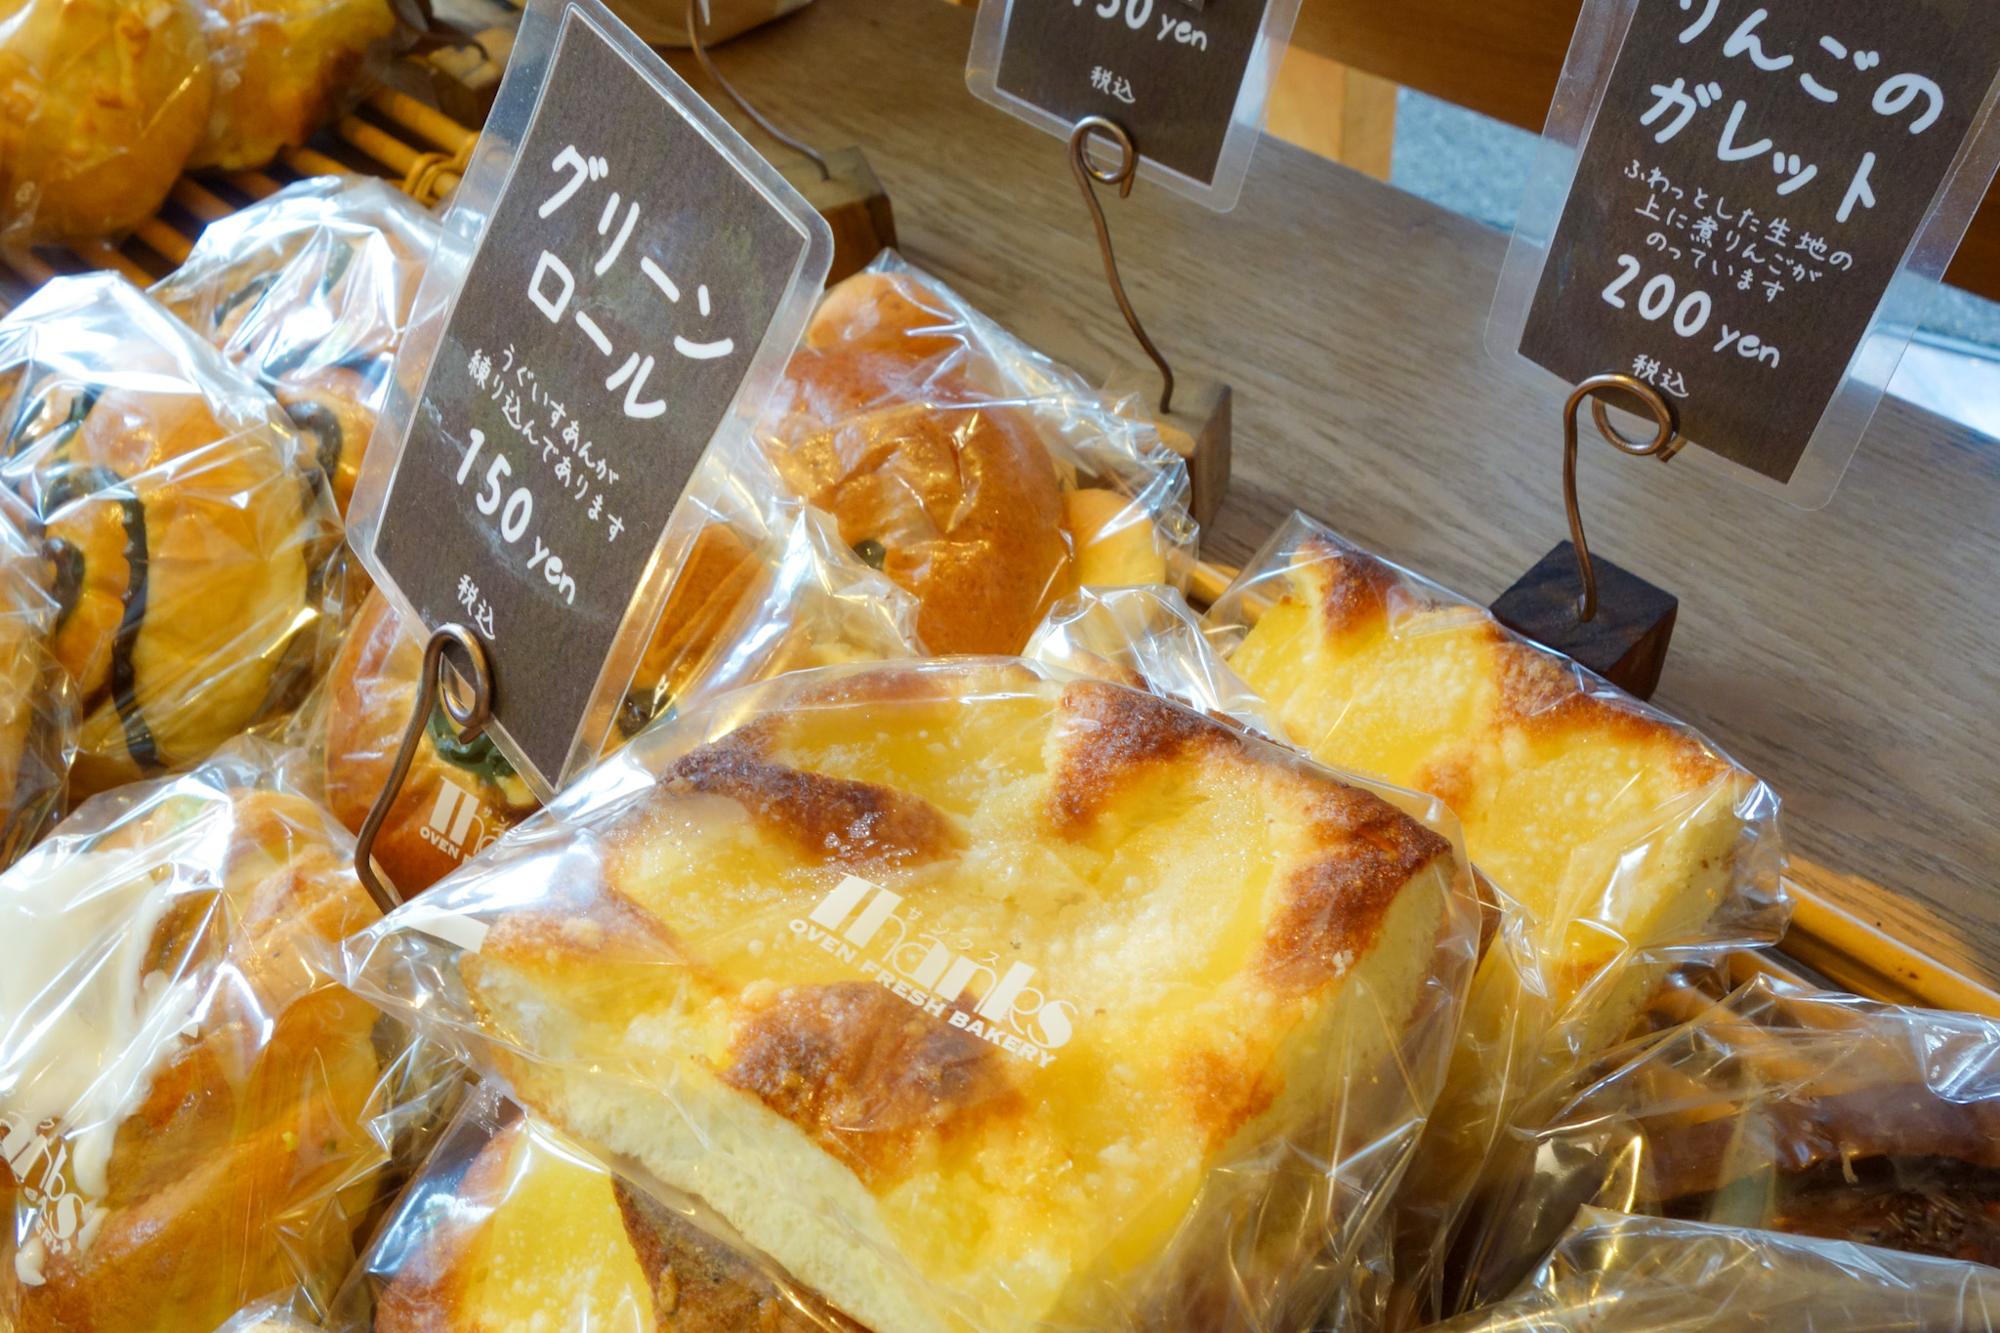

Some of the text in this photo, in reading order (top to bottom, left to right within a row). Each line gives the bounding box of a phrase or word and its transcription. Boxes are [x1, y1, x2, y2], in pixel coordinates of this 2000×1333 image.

[1090, 65, 1136, 104] 税込
[1156, 13, 1207, 51] yen
[1679, 0, 1943, 134] りんごの
[1640, 77, 1876, 223] ガレット
[538, 144, 734, 360] グリーン
[1624, 159, 1853, 271] ふわっとした生地の
[1635, 193, 1822, 283] 上に煮りんごが
[1646, 232, 1785, 302] のっています
[528, 249, 667, 419] ロール
[1601, 253, 1780, 369] 200 yen
[503, 343, 620, 484] うぐいすあんが
[1632, 354, 1689, 398] 税込
[468, 348, 624, 542] 練り込んであります
[457, 427, 576, 605] 150 yen
[458, 574, 496, 640] 税込
[420, 825, 460, 859] OVEN
[788, 918, 1056, 1068] OVEN FRESH BAKERY
